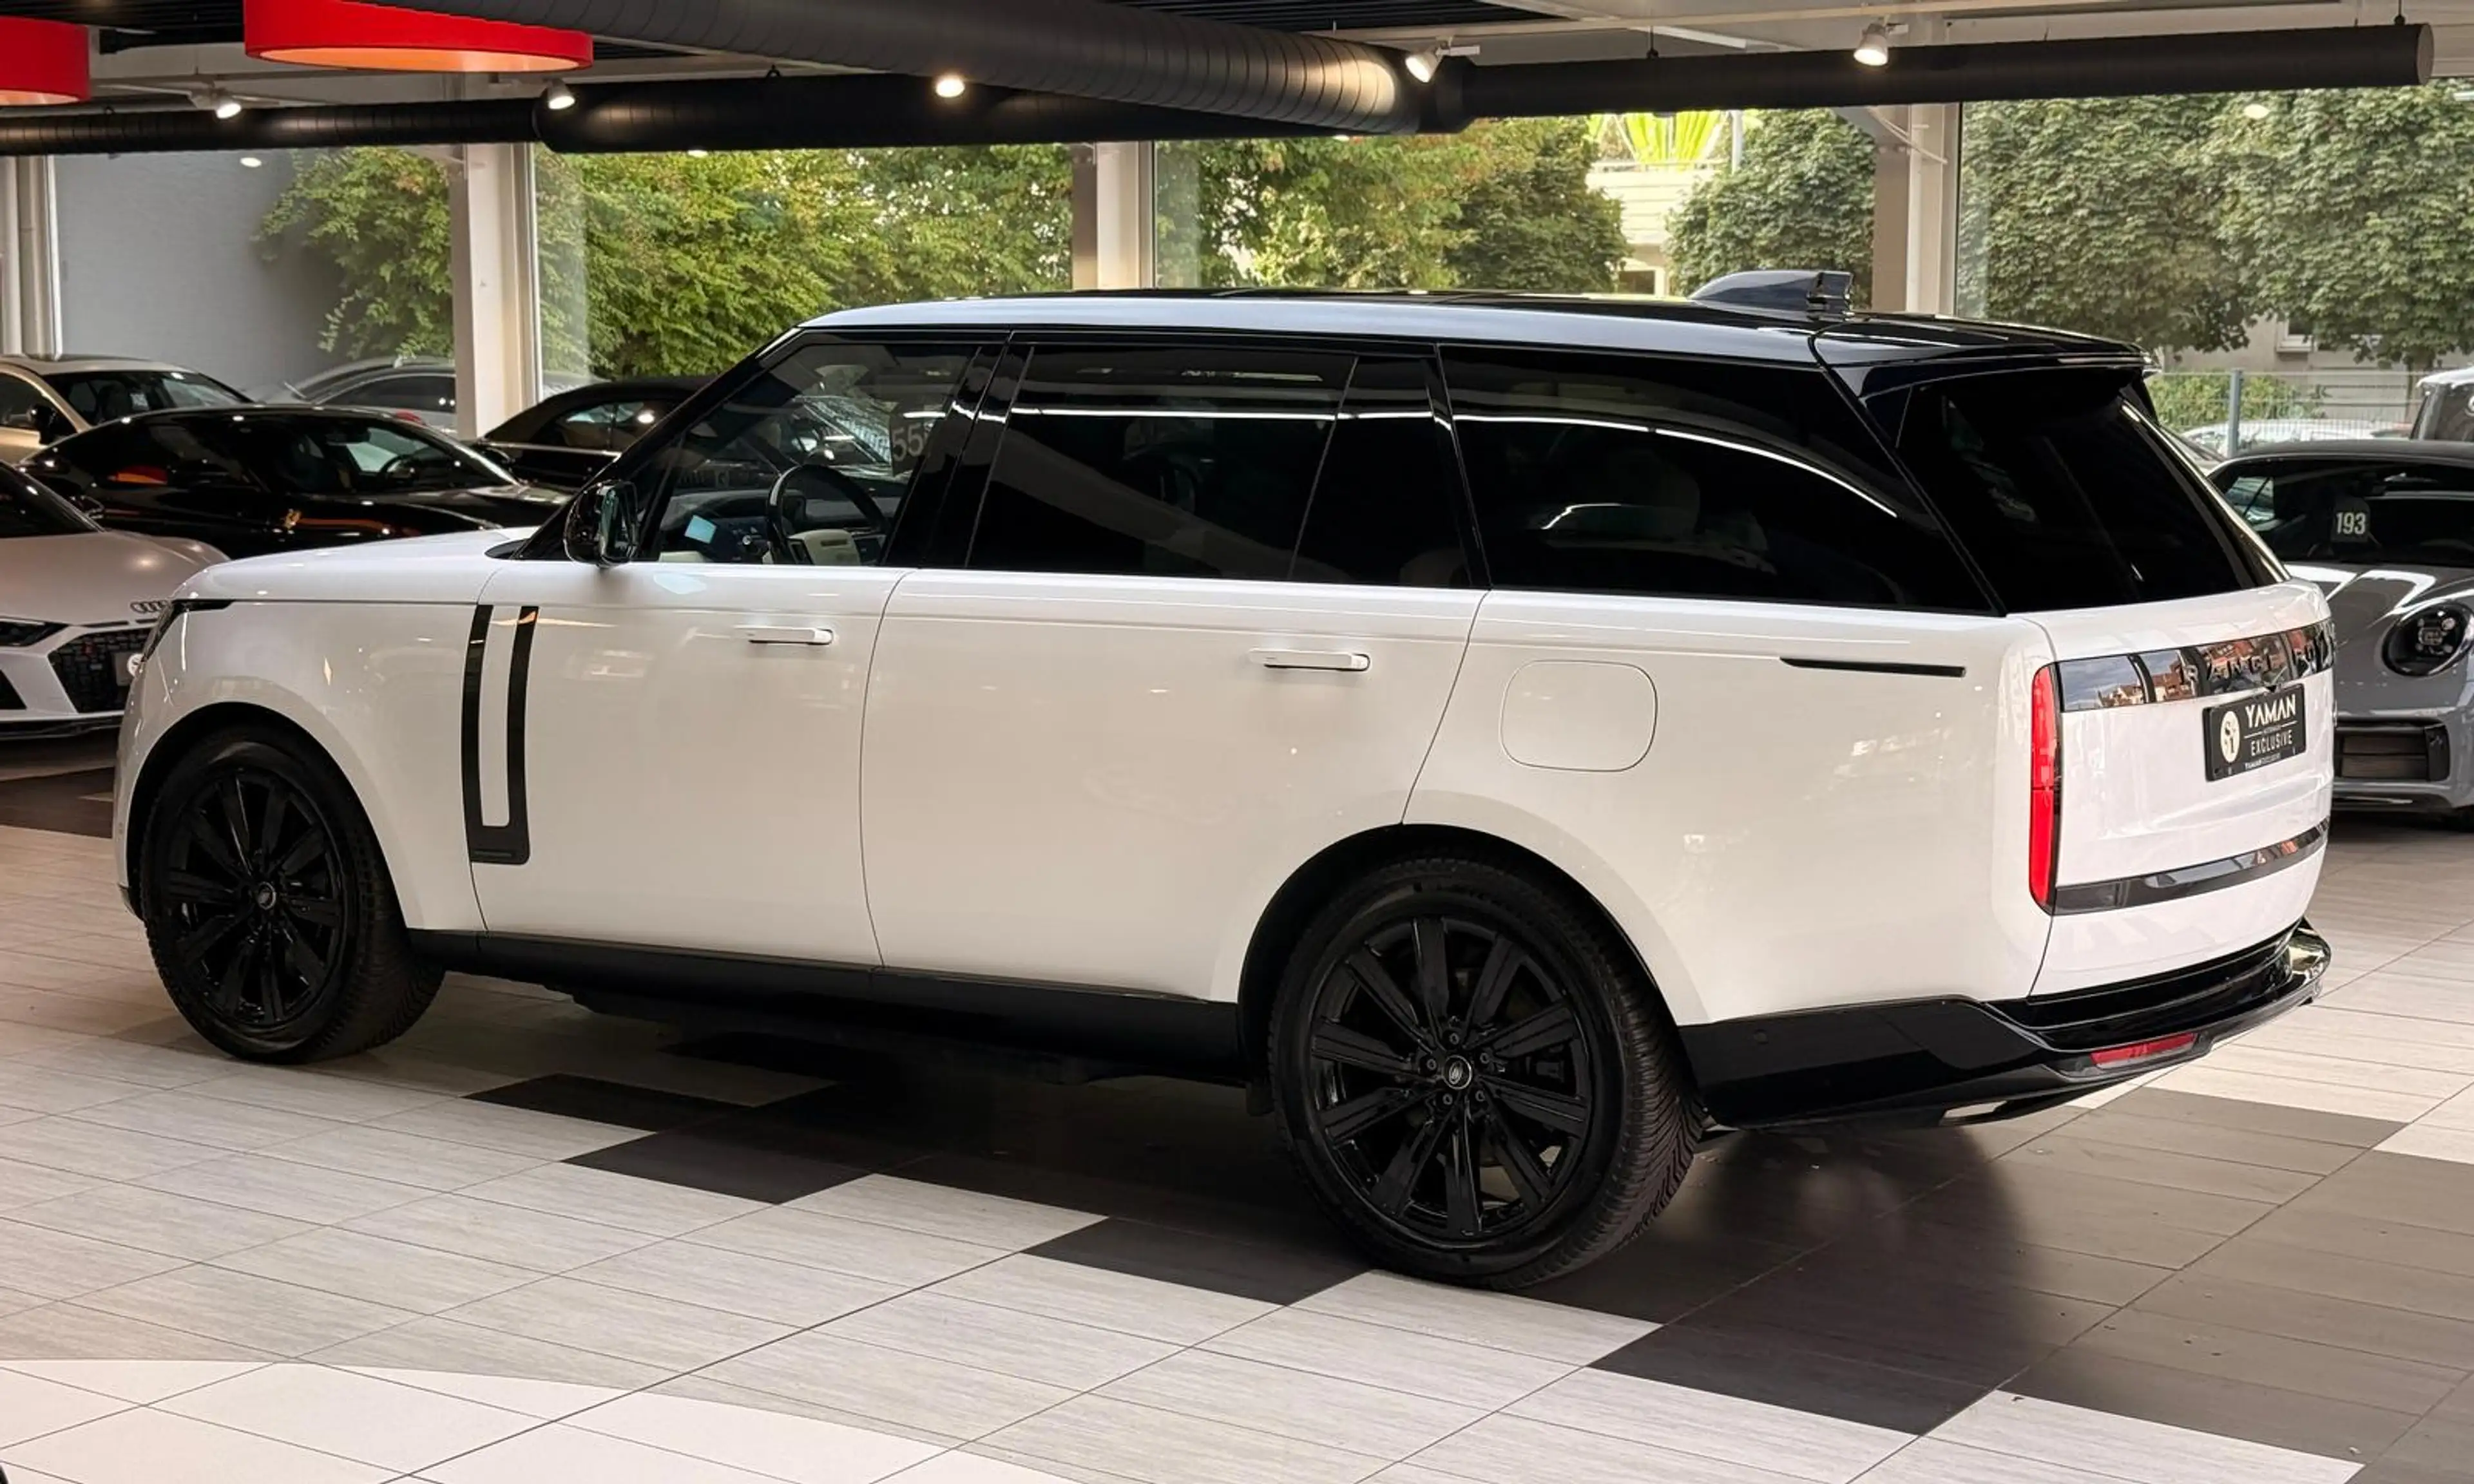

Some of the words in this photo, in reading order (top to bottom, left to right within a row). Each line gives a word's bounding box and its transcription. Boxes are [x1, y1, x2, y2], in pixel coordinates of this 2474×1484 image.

[2336, 512, 2366, 535] 193
[2245, 694, 2296, 728] YAMAN
[2250, 729, 2293, 756] EXCLUSIVE
